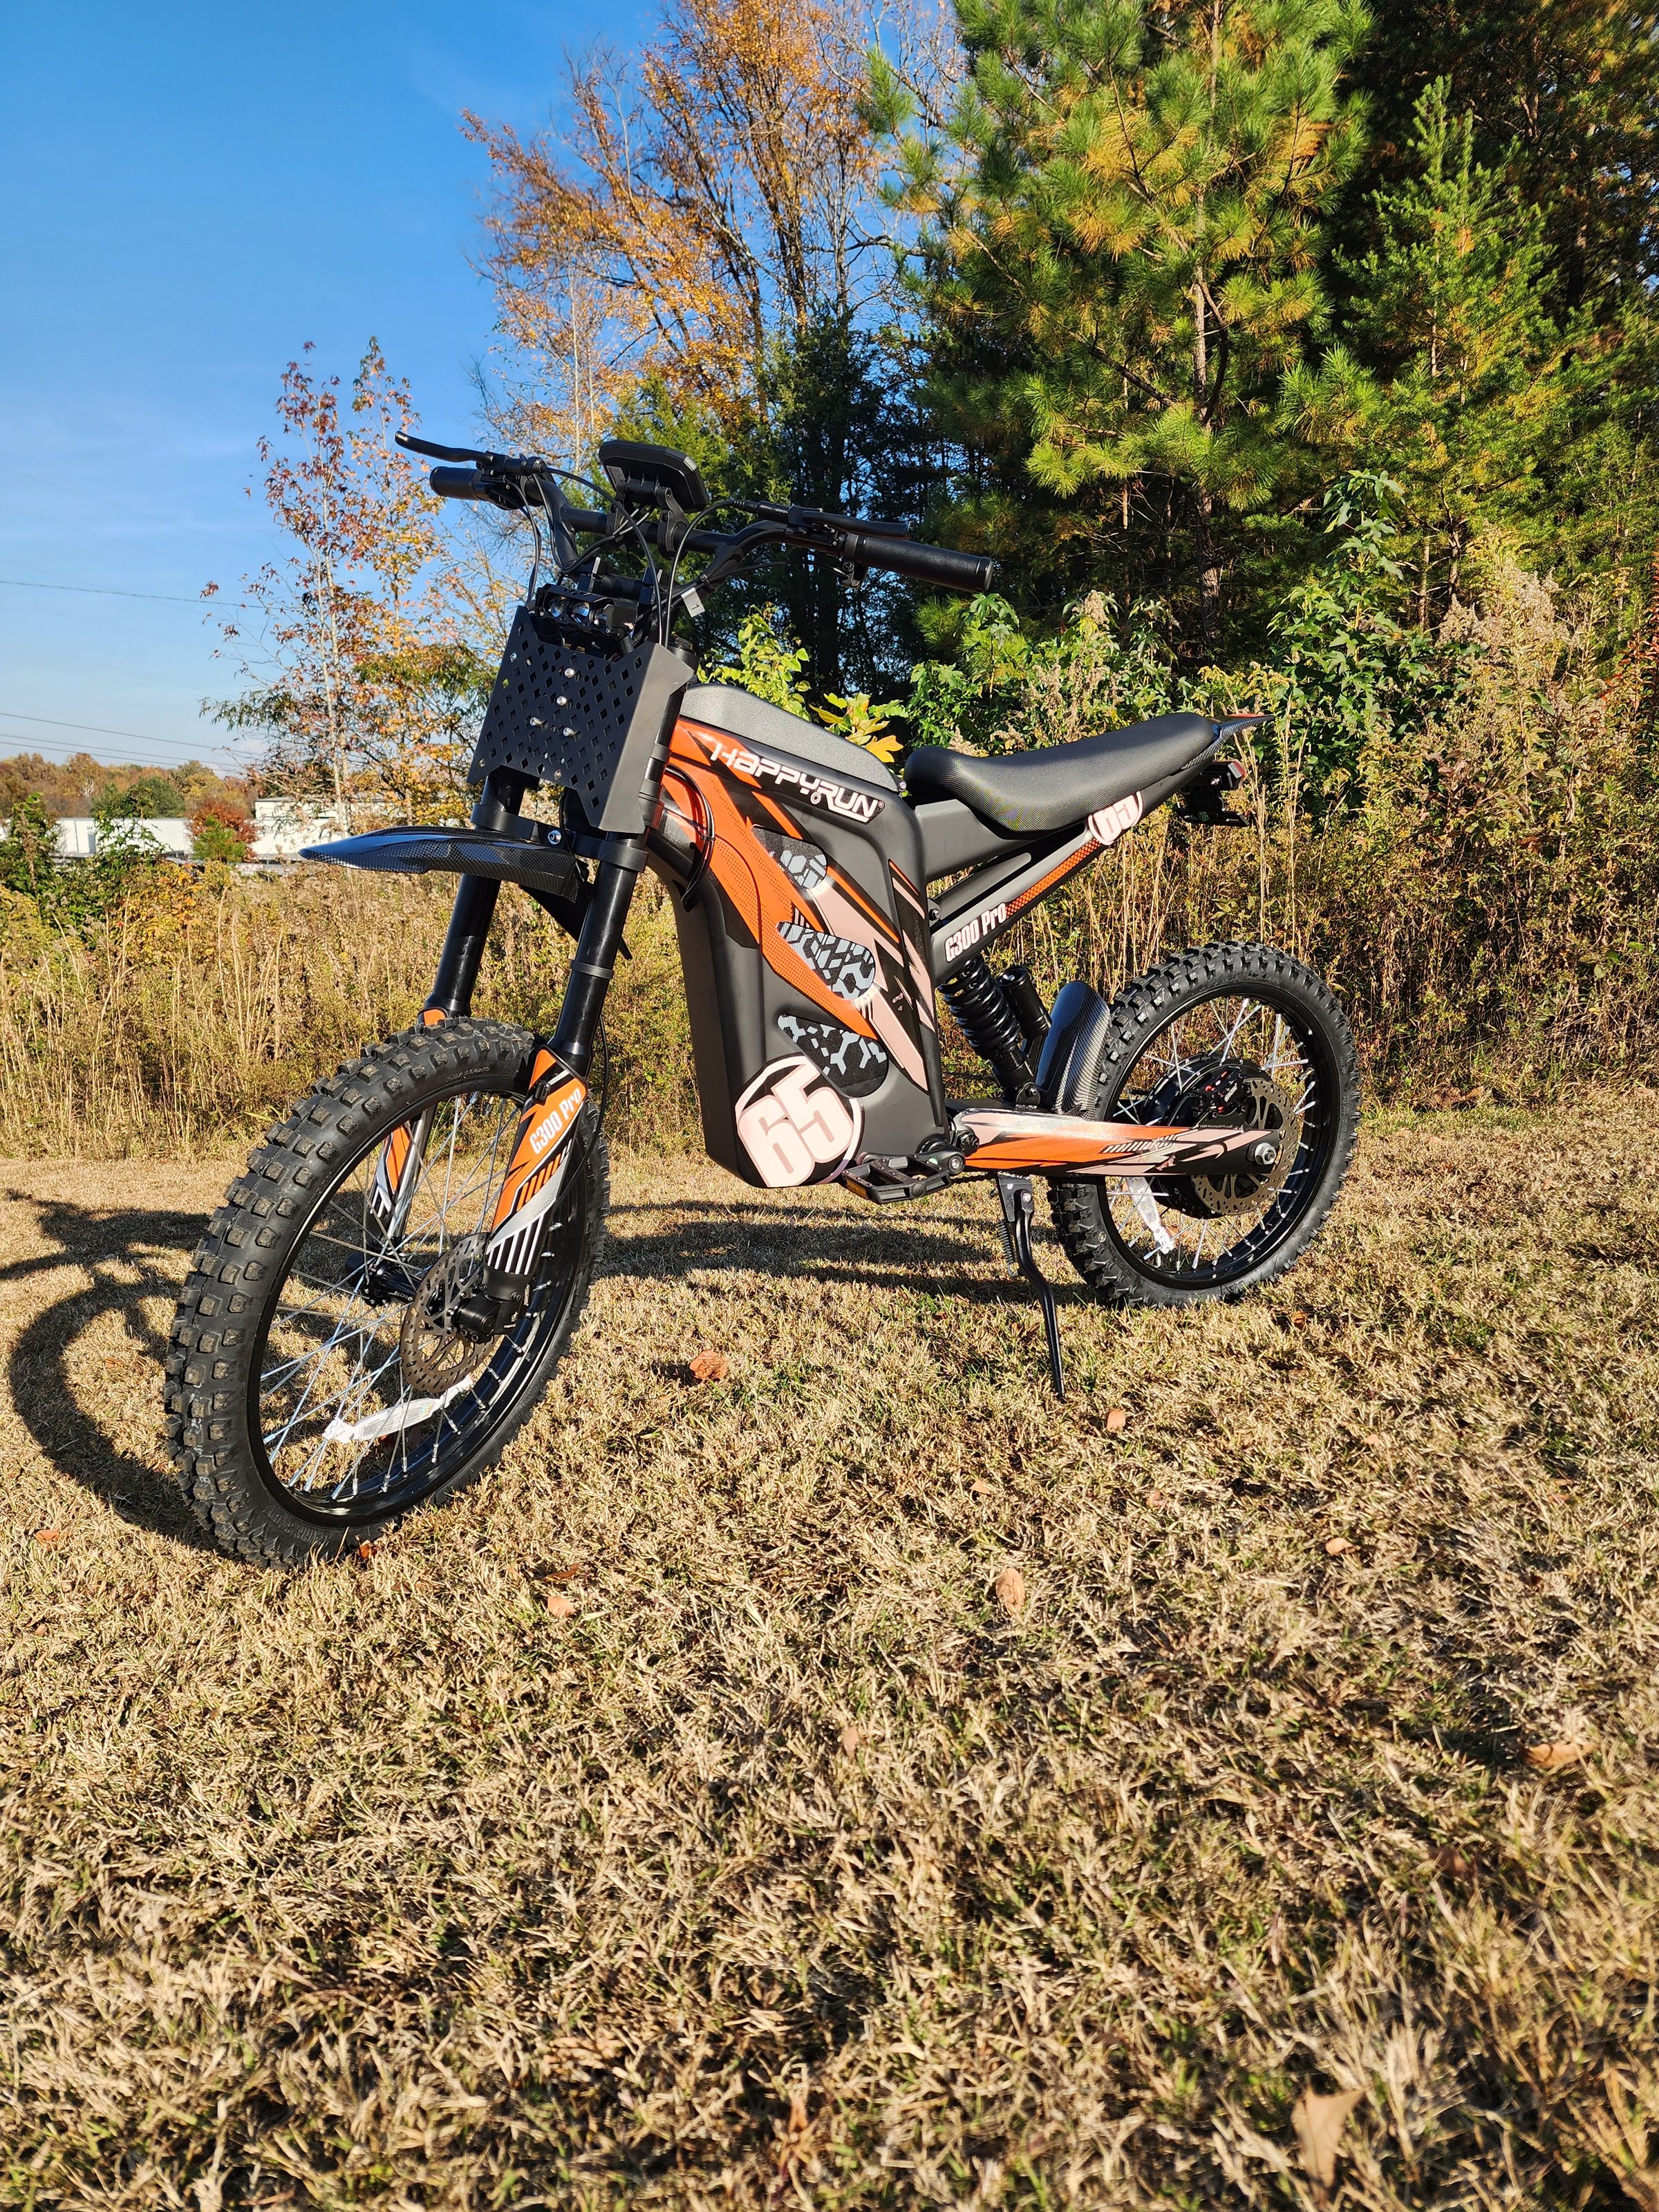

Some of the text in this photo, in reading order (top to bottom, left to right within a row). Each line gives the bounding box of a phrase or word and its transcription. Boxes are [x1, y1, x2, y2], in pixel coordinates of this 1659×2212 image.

[945, 903, 1006, 962] G300 Pro
[529, 1088, 581, 1154] G300 Pro
[738, 1062, 854, 1188] 65
